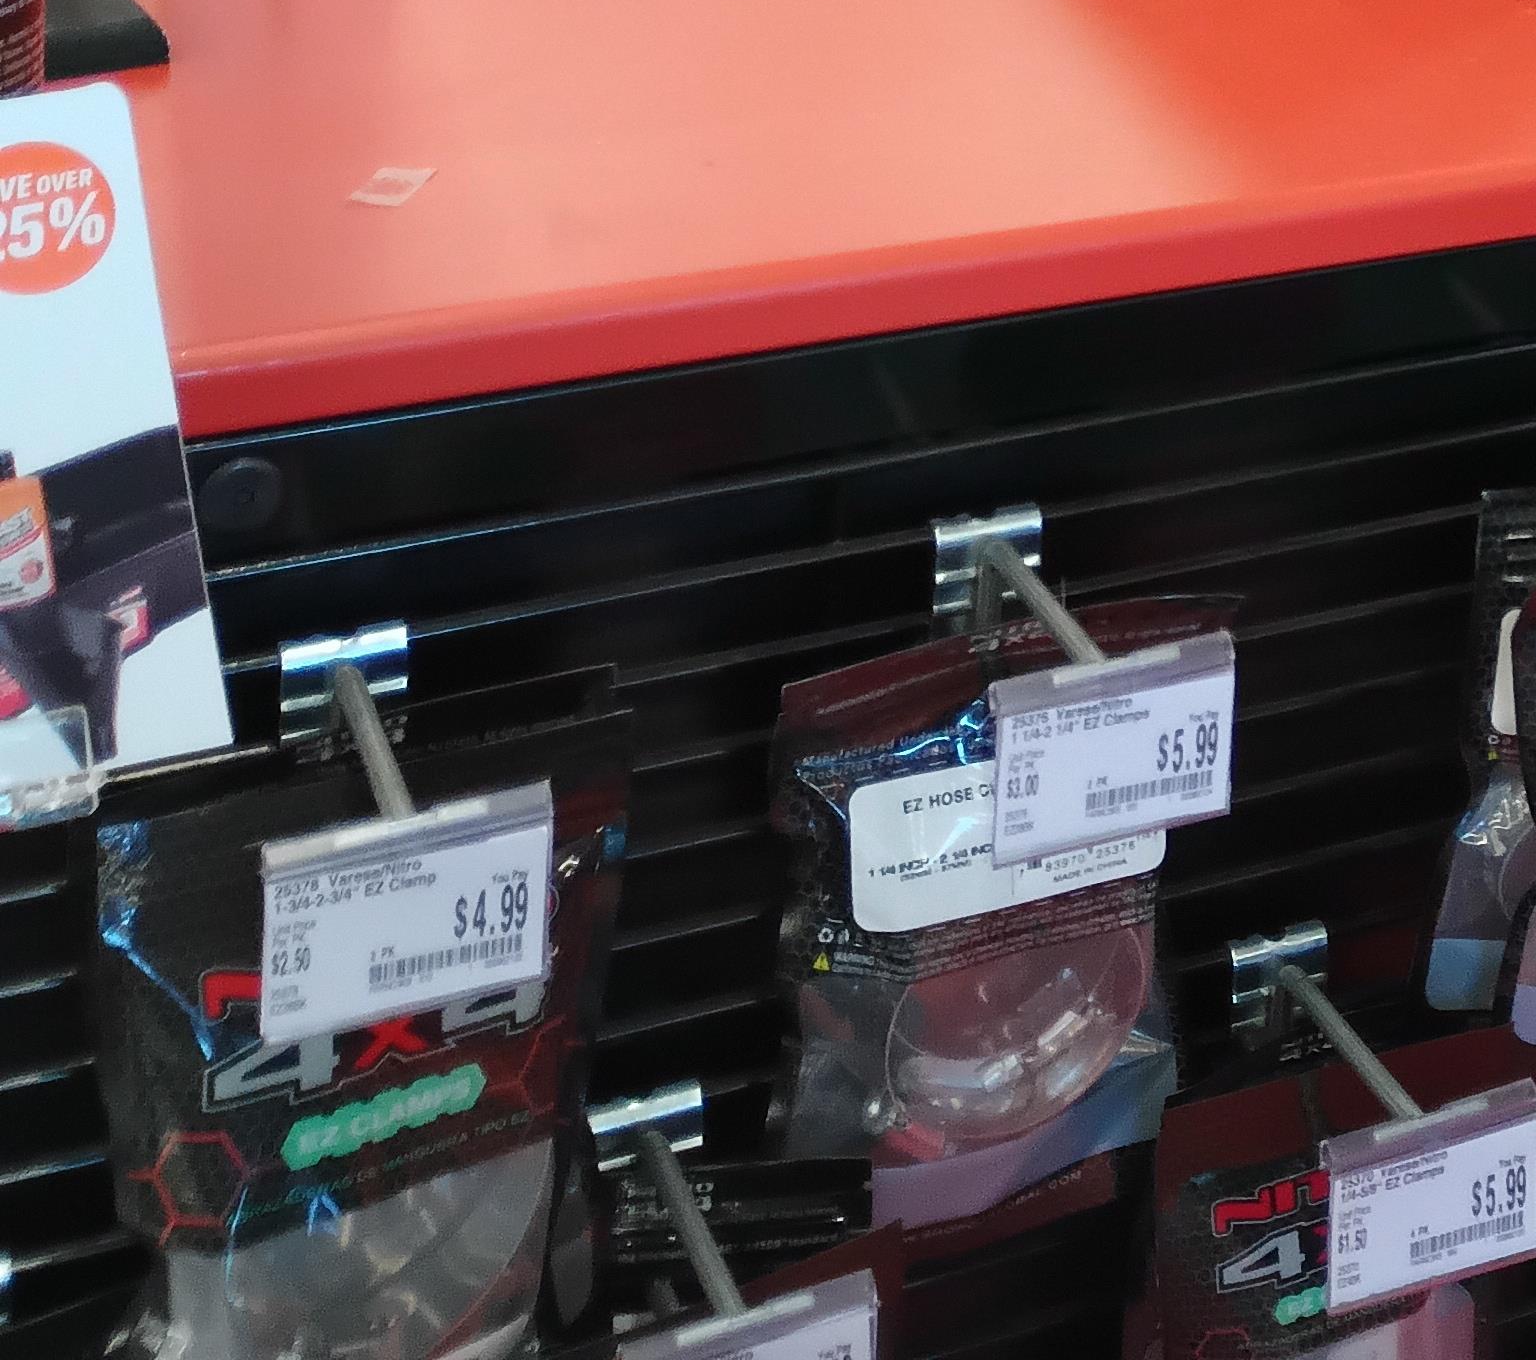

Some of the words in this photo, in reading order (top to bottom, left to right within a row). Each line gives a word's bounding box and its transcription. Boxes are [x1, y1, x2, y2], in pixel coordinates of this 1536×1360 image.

[35, 166, 94, 197] OVER
[1083, 717, 1100, 731] EZ
[1156, 721, 1220, 774] $5.99
[901, 797, 925, 815] EZ
[928, 786, 975, 810] HOSE
[363, 880, 385, 898] EZ
[388, 872, 437, 892] Clamp
[453, 881, 529, 941] $4.99
[1384, 1177, 1401, 1191] EZ
[1471, 1164, 1527, 1217] $5.99
